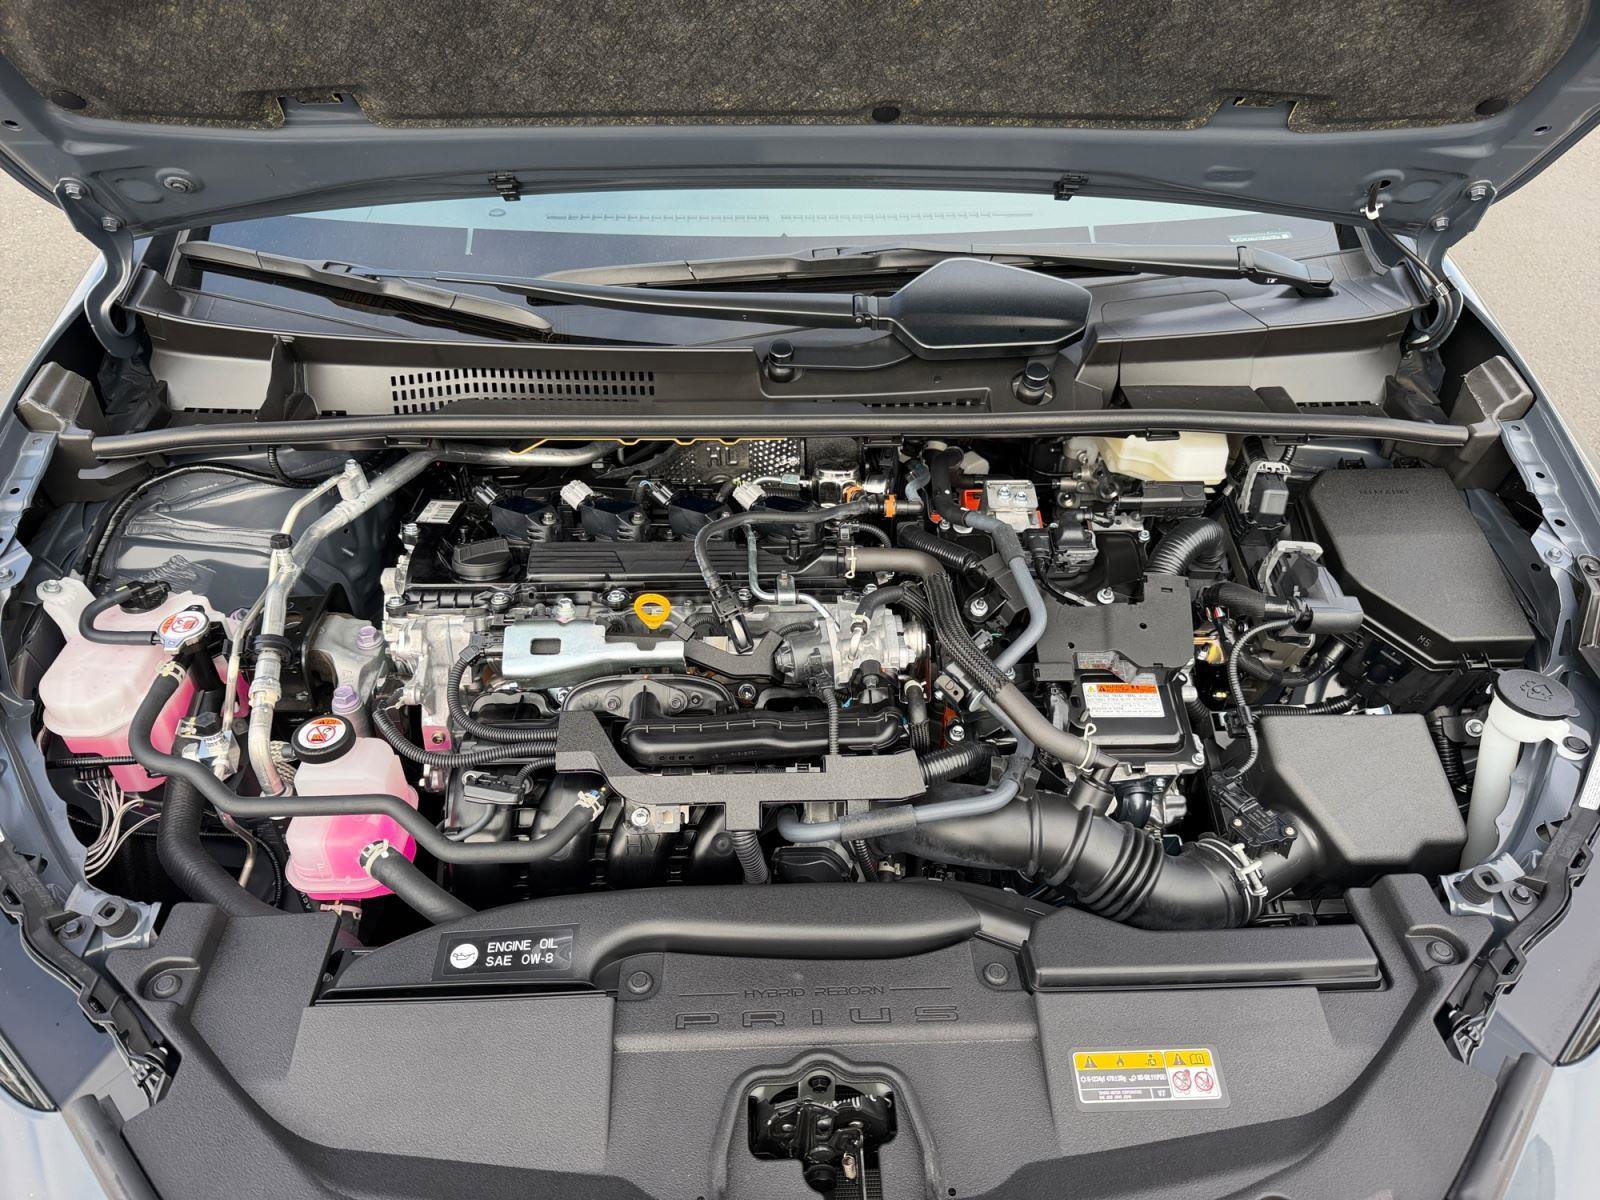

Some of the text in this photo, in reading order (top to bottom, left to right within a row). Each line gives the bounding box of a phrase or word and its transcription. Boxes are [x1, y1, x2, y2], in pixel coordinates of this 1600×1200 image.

[487, 938, 558, 953] ENGINE OIL
[485, 952, 554, 967] SAE 0W-8
[744, 985, 885, 998] HYBRID REBORN
[675, 1005, 959, 1030] PRIUS
